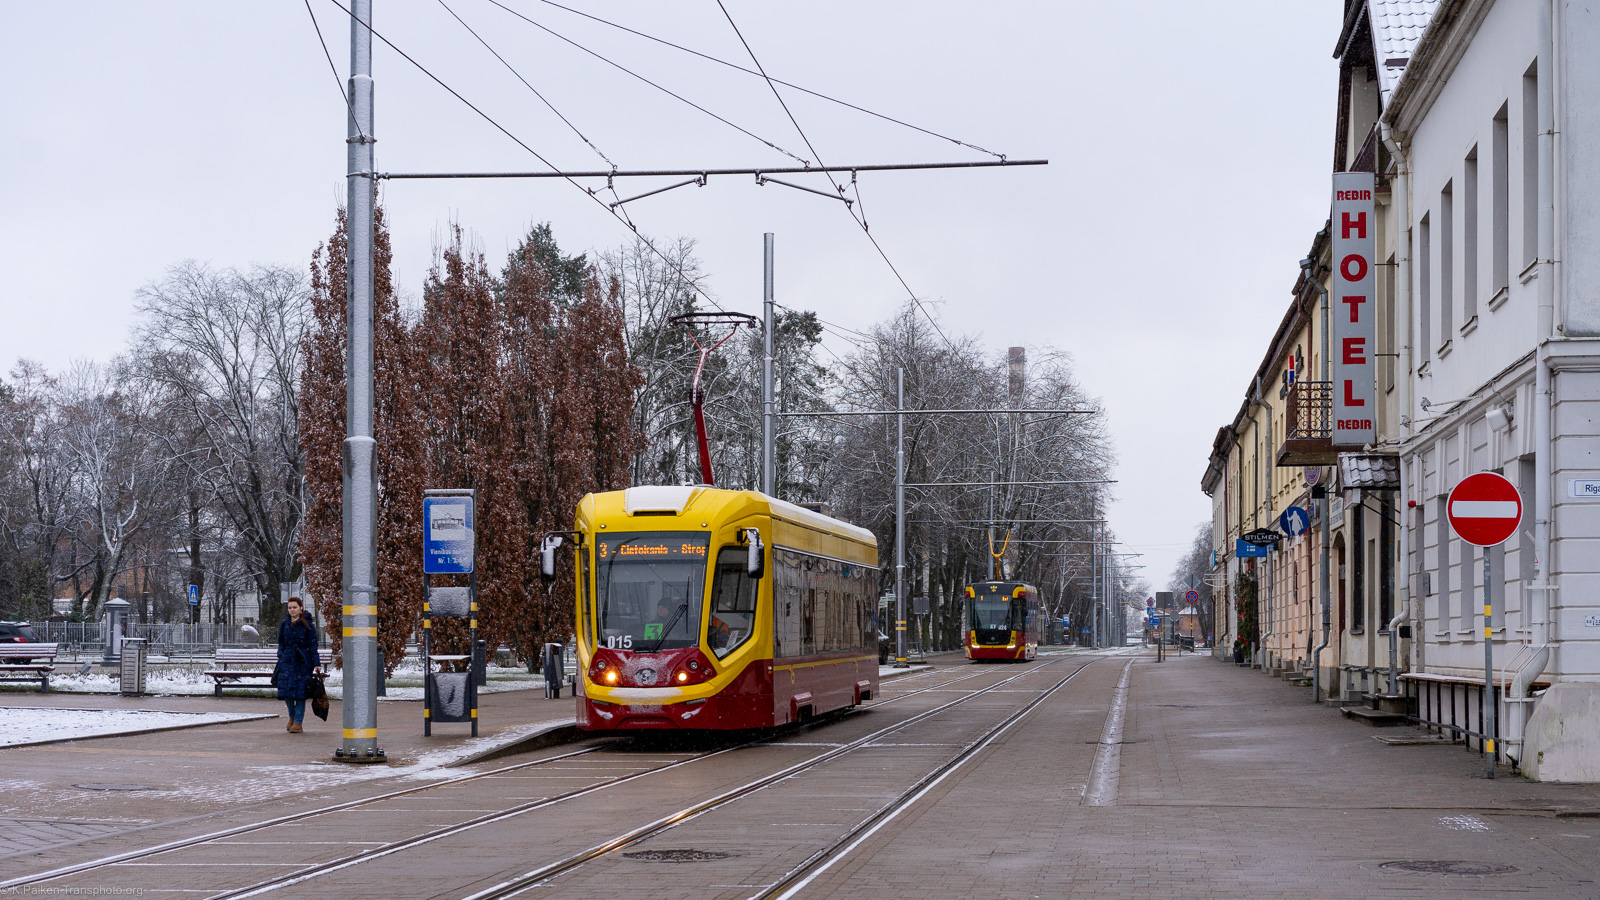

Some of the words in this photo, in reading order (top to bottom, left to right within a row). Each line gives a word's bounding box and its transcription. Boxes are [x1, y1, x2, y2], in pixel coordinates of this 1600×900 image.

[1336, 190, 1371, 201] REBIR
[1340, 211, 1368, 407] HOTEL
[1337, 419, 1372, 430] REBIR
[599, 543, 608, 558] 3
[647, 625, 660, 640] 3
[607, 635, 632, 649] 015
